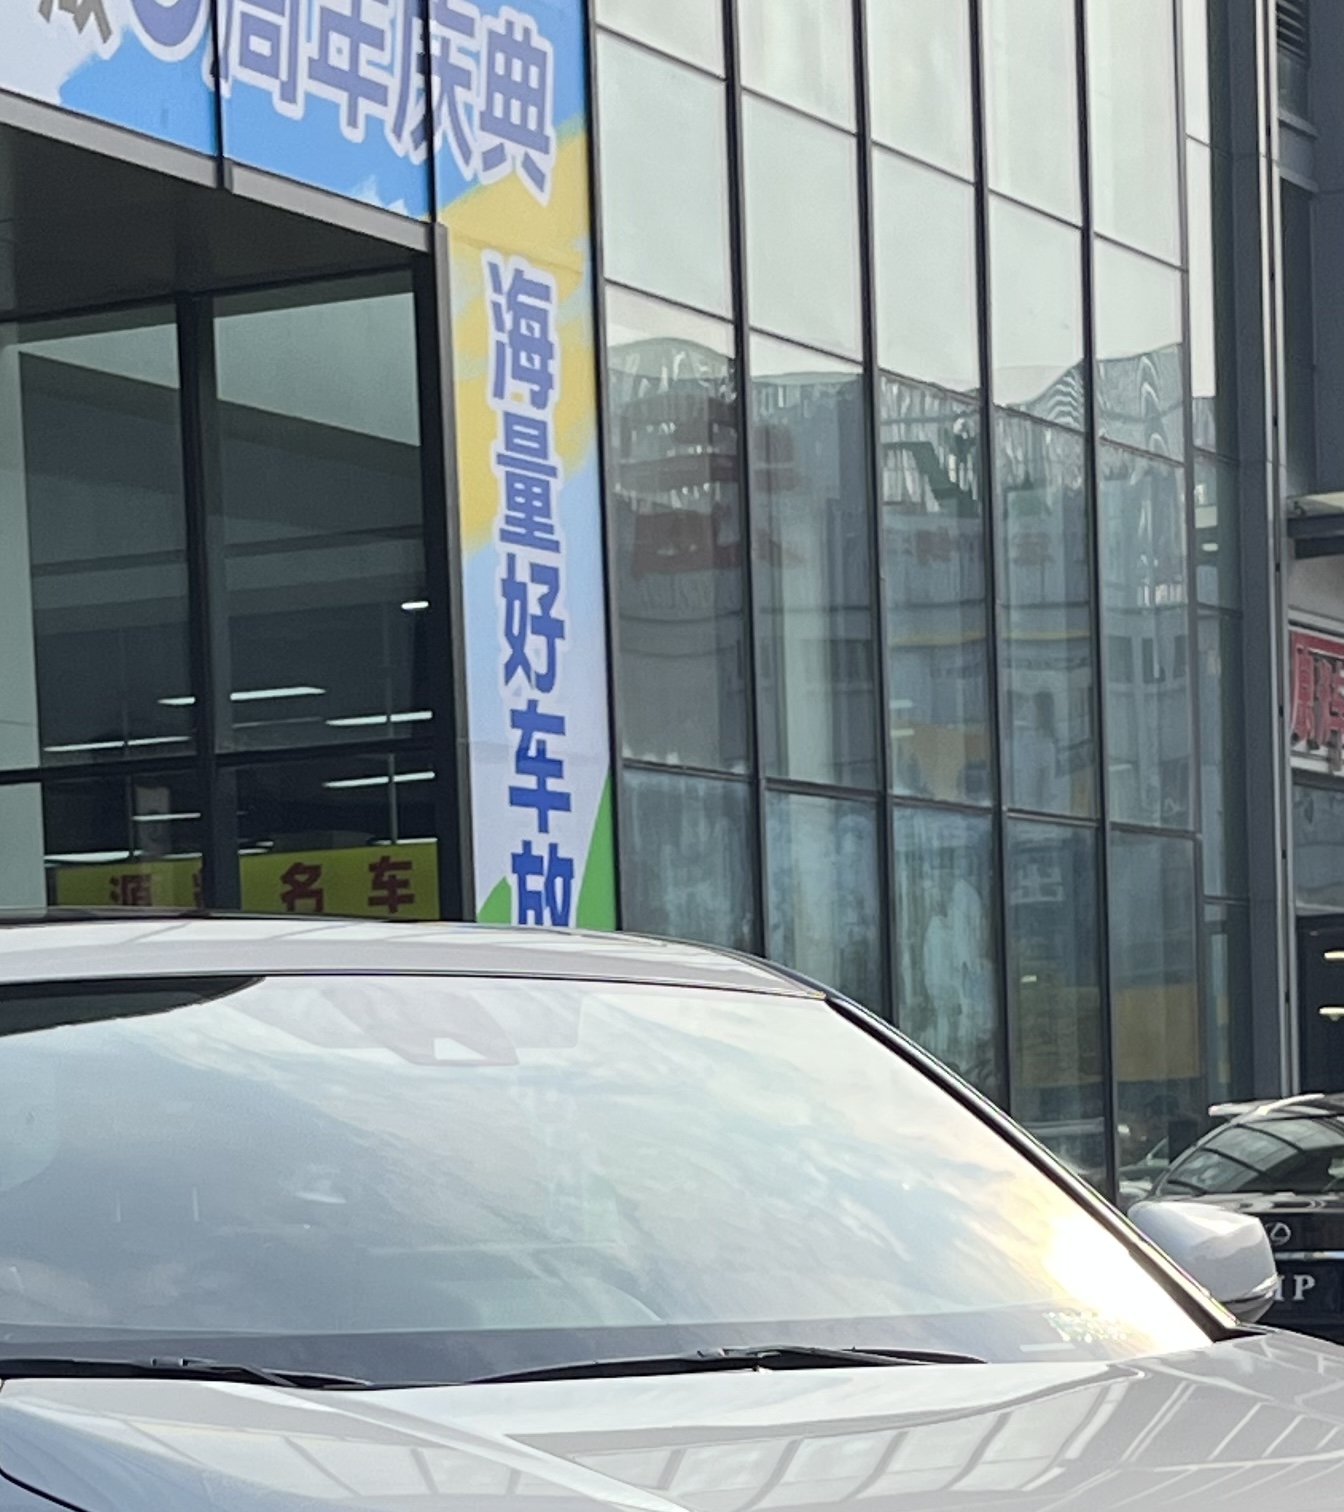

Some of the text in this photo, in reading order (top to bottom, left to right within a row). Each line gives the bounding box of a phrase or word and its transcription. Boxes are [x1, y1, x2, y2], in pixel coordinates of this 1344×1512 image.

[486, 260, 575, 926] 海量好车放
